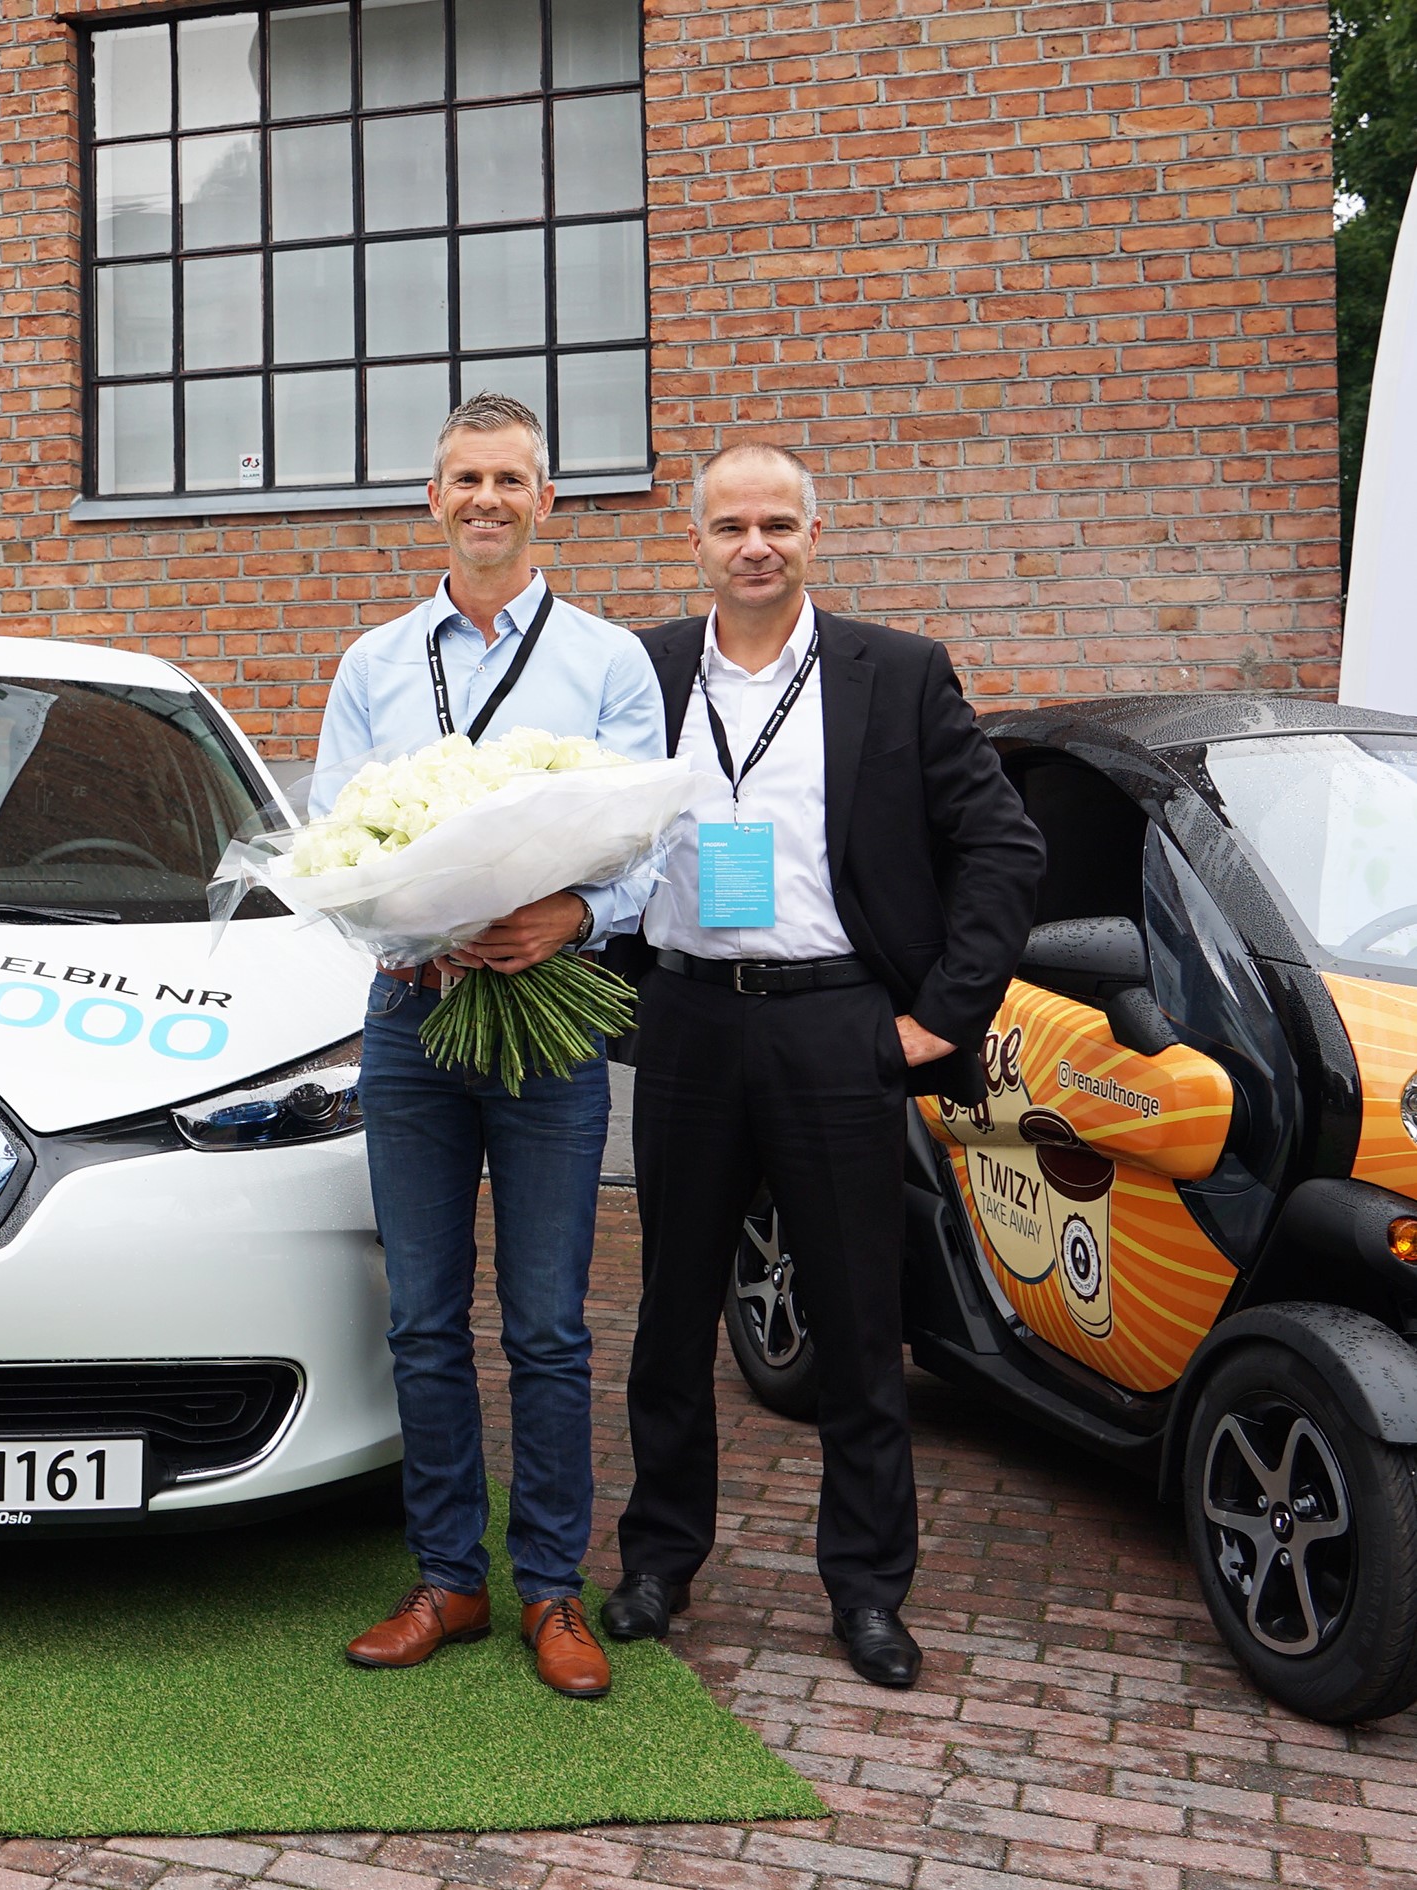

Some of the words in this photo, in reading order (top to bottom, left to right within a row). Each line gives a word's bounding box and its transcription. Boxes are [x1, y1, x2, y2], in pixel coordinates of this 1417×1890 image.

[0, 956, 139, 996] ELBIL
[155, 983, 233, 1008] NR
[1072, 1071, 1159, 1118] renaultnorge
[977, 1151, 1041, 1215] TWIZY
[980, 1191, 1007, 1226] TAKE
[1010, 1209, 1042, 1244] AWAY
